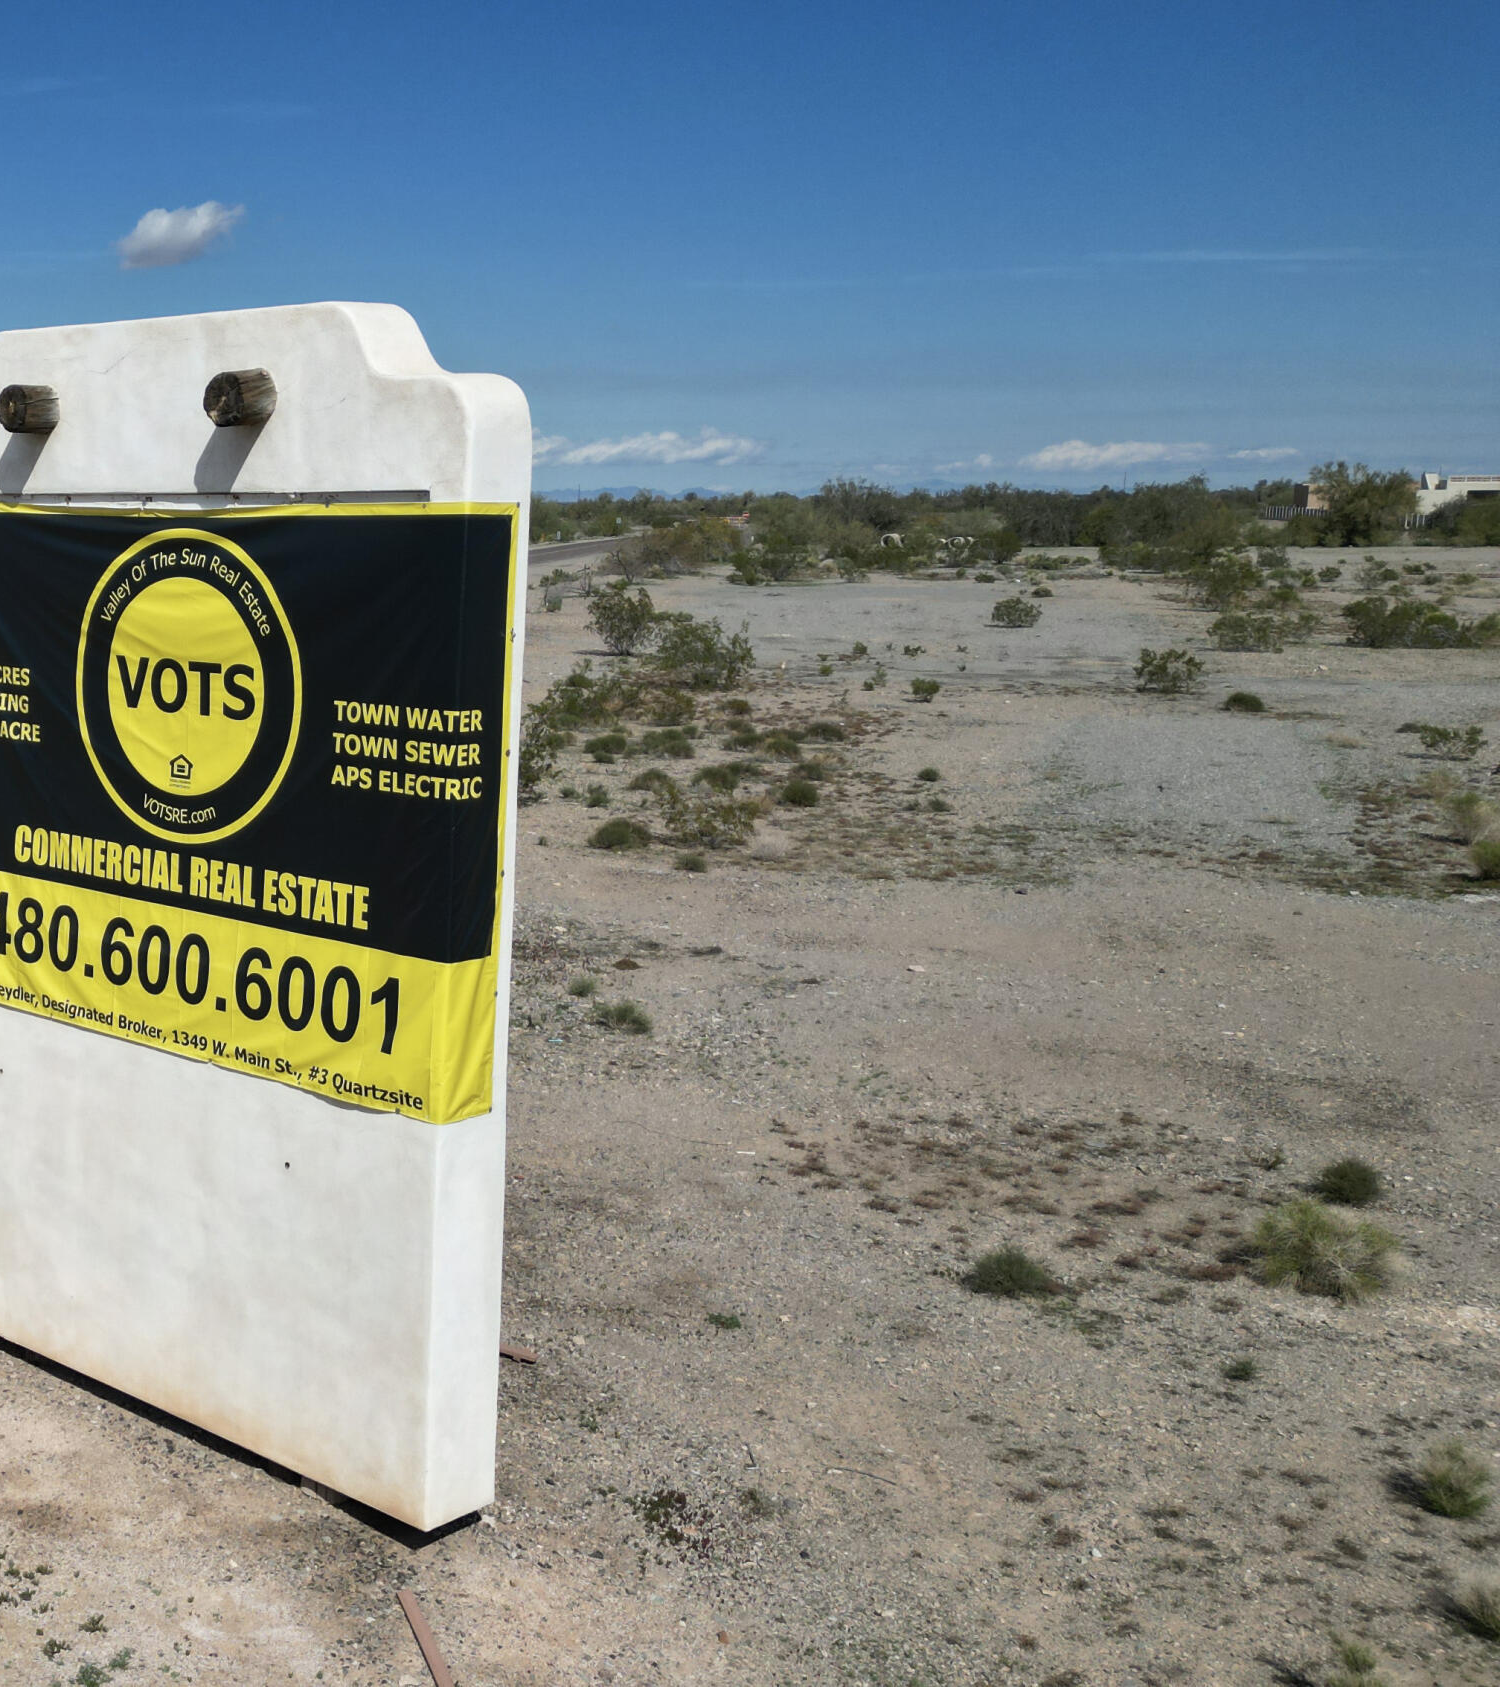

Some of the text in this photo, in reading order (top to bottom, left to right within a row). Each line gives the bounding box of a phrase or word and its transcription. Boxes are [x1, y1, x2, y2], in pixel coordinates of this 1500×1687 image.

[100, 548, 271, 637] Valley Of The Sun Real Estate
[116, 654, 256, 721] VOTS
[333, 699, 483, 733] TOWN WATER
[332, 732, 481, 767] TOWN SEWER
[143, 792, 217, 824] VOTSRE.com
[330, 764, 483, 801] APS ELECTRIC
[14, 824, 370, 931] COMMERCIAL REAL ESTATE
[41, 994, 114, 1026] Designated
[117, 1014, 167, 1043] Broker,
[171, 1029, 208, 1051] 1349
[212, 1039, 230, 1059] W.
[234, 1046, 271, 1070] Main
[274, 1057, 303, 1080] St.,
[307, 1065, 329, 1085] #3
[332, 1072, 423, 1110] Quartzsite
